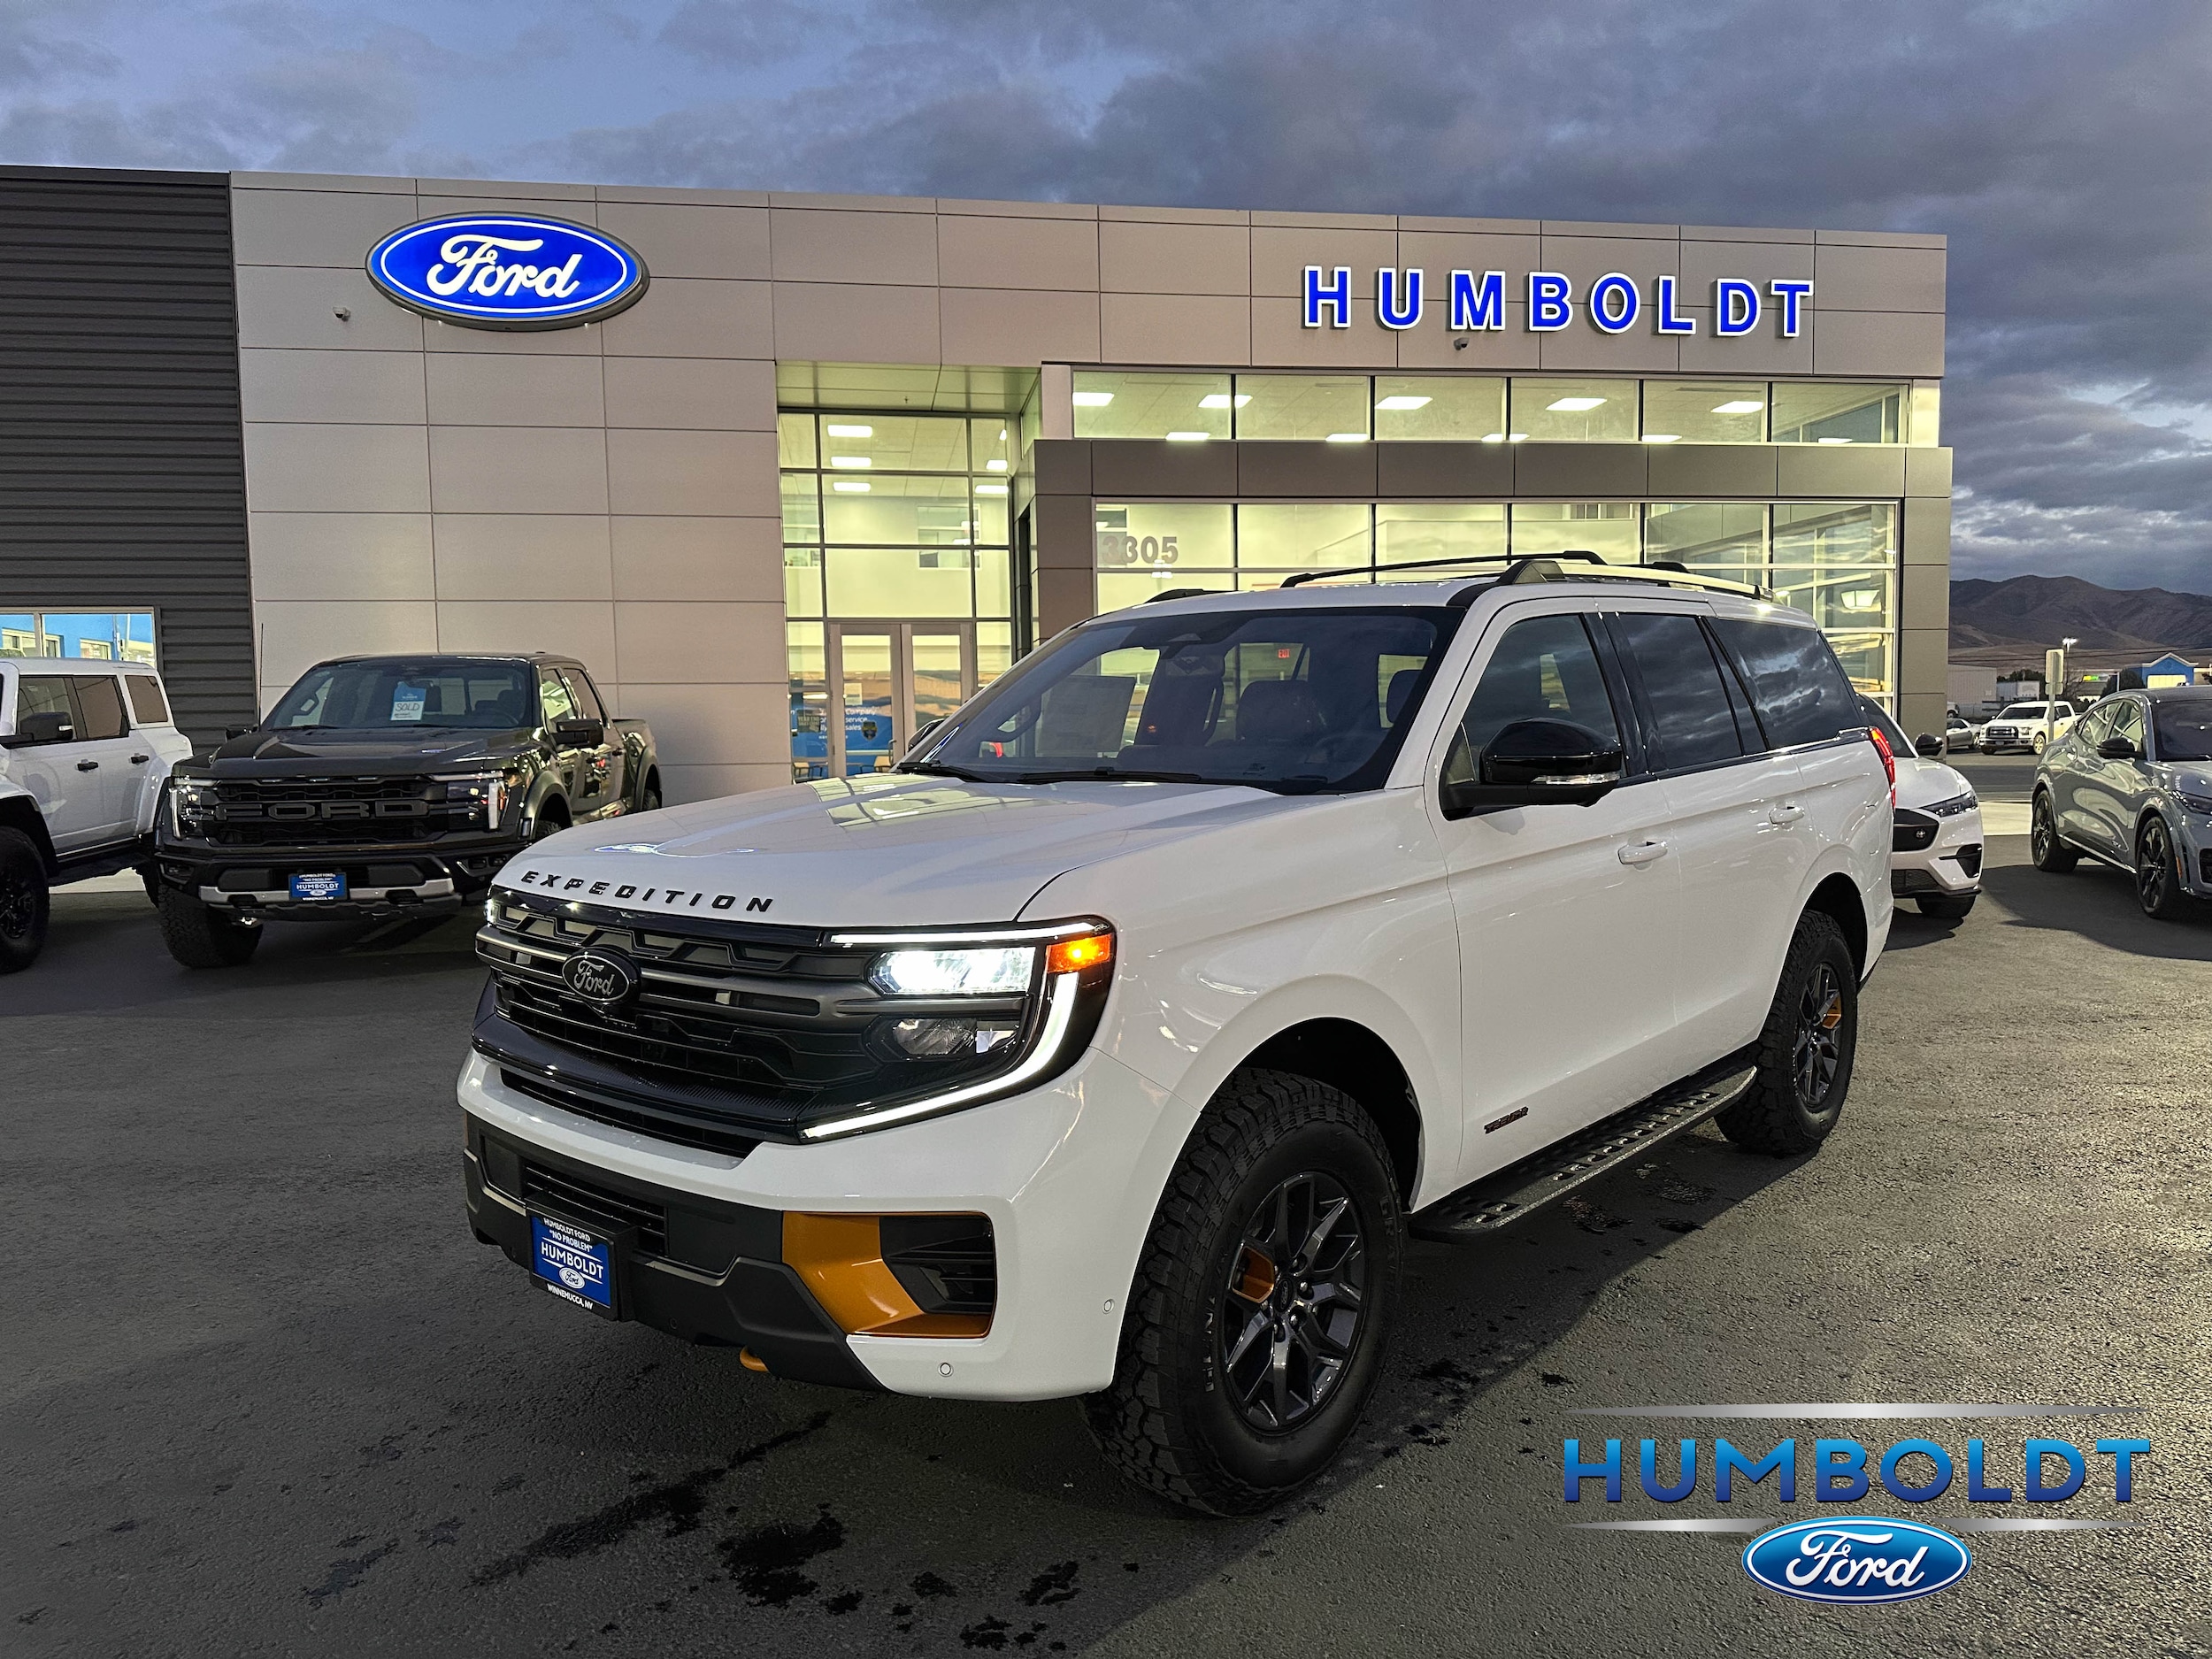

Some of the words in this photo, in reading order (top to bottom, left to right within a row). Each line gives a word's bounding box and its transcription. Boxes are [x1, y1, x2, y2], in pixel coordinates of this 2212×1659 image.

[426, 234, 582, 297] Ford
[1303, 265, 1814, 338] HUMBOLDT
[1102, 535, 1179, 565] 3305
[396, 703, 420, 711] SOLD
[215, 800, 429, 821] FORD
[520, 870, 773, 913] EXPEDITION
[574, 960, 615, 995] Ford
[543, 1217, 574, 1235] HUMBOLDT
[573, 1227, 591, 1242] FORD
[549, 1229, 562, 1240] "NO
[562, 1234, 593, 1253] PROBLEM"
[541, 1241, 603, 1279] HUMBOLDT
[565, 1271, 580, 1285] Ford
[547, 1283, 585, 1308] WINNEMUCCA,
[584, 1299, 594, 1310] NV
